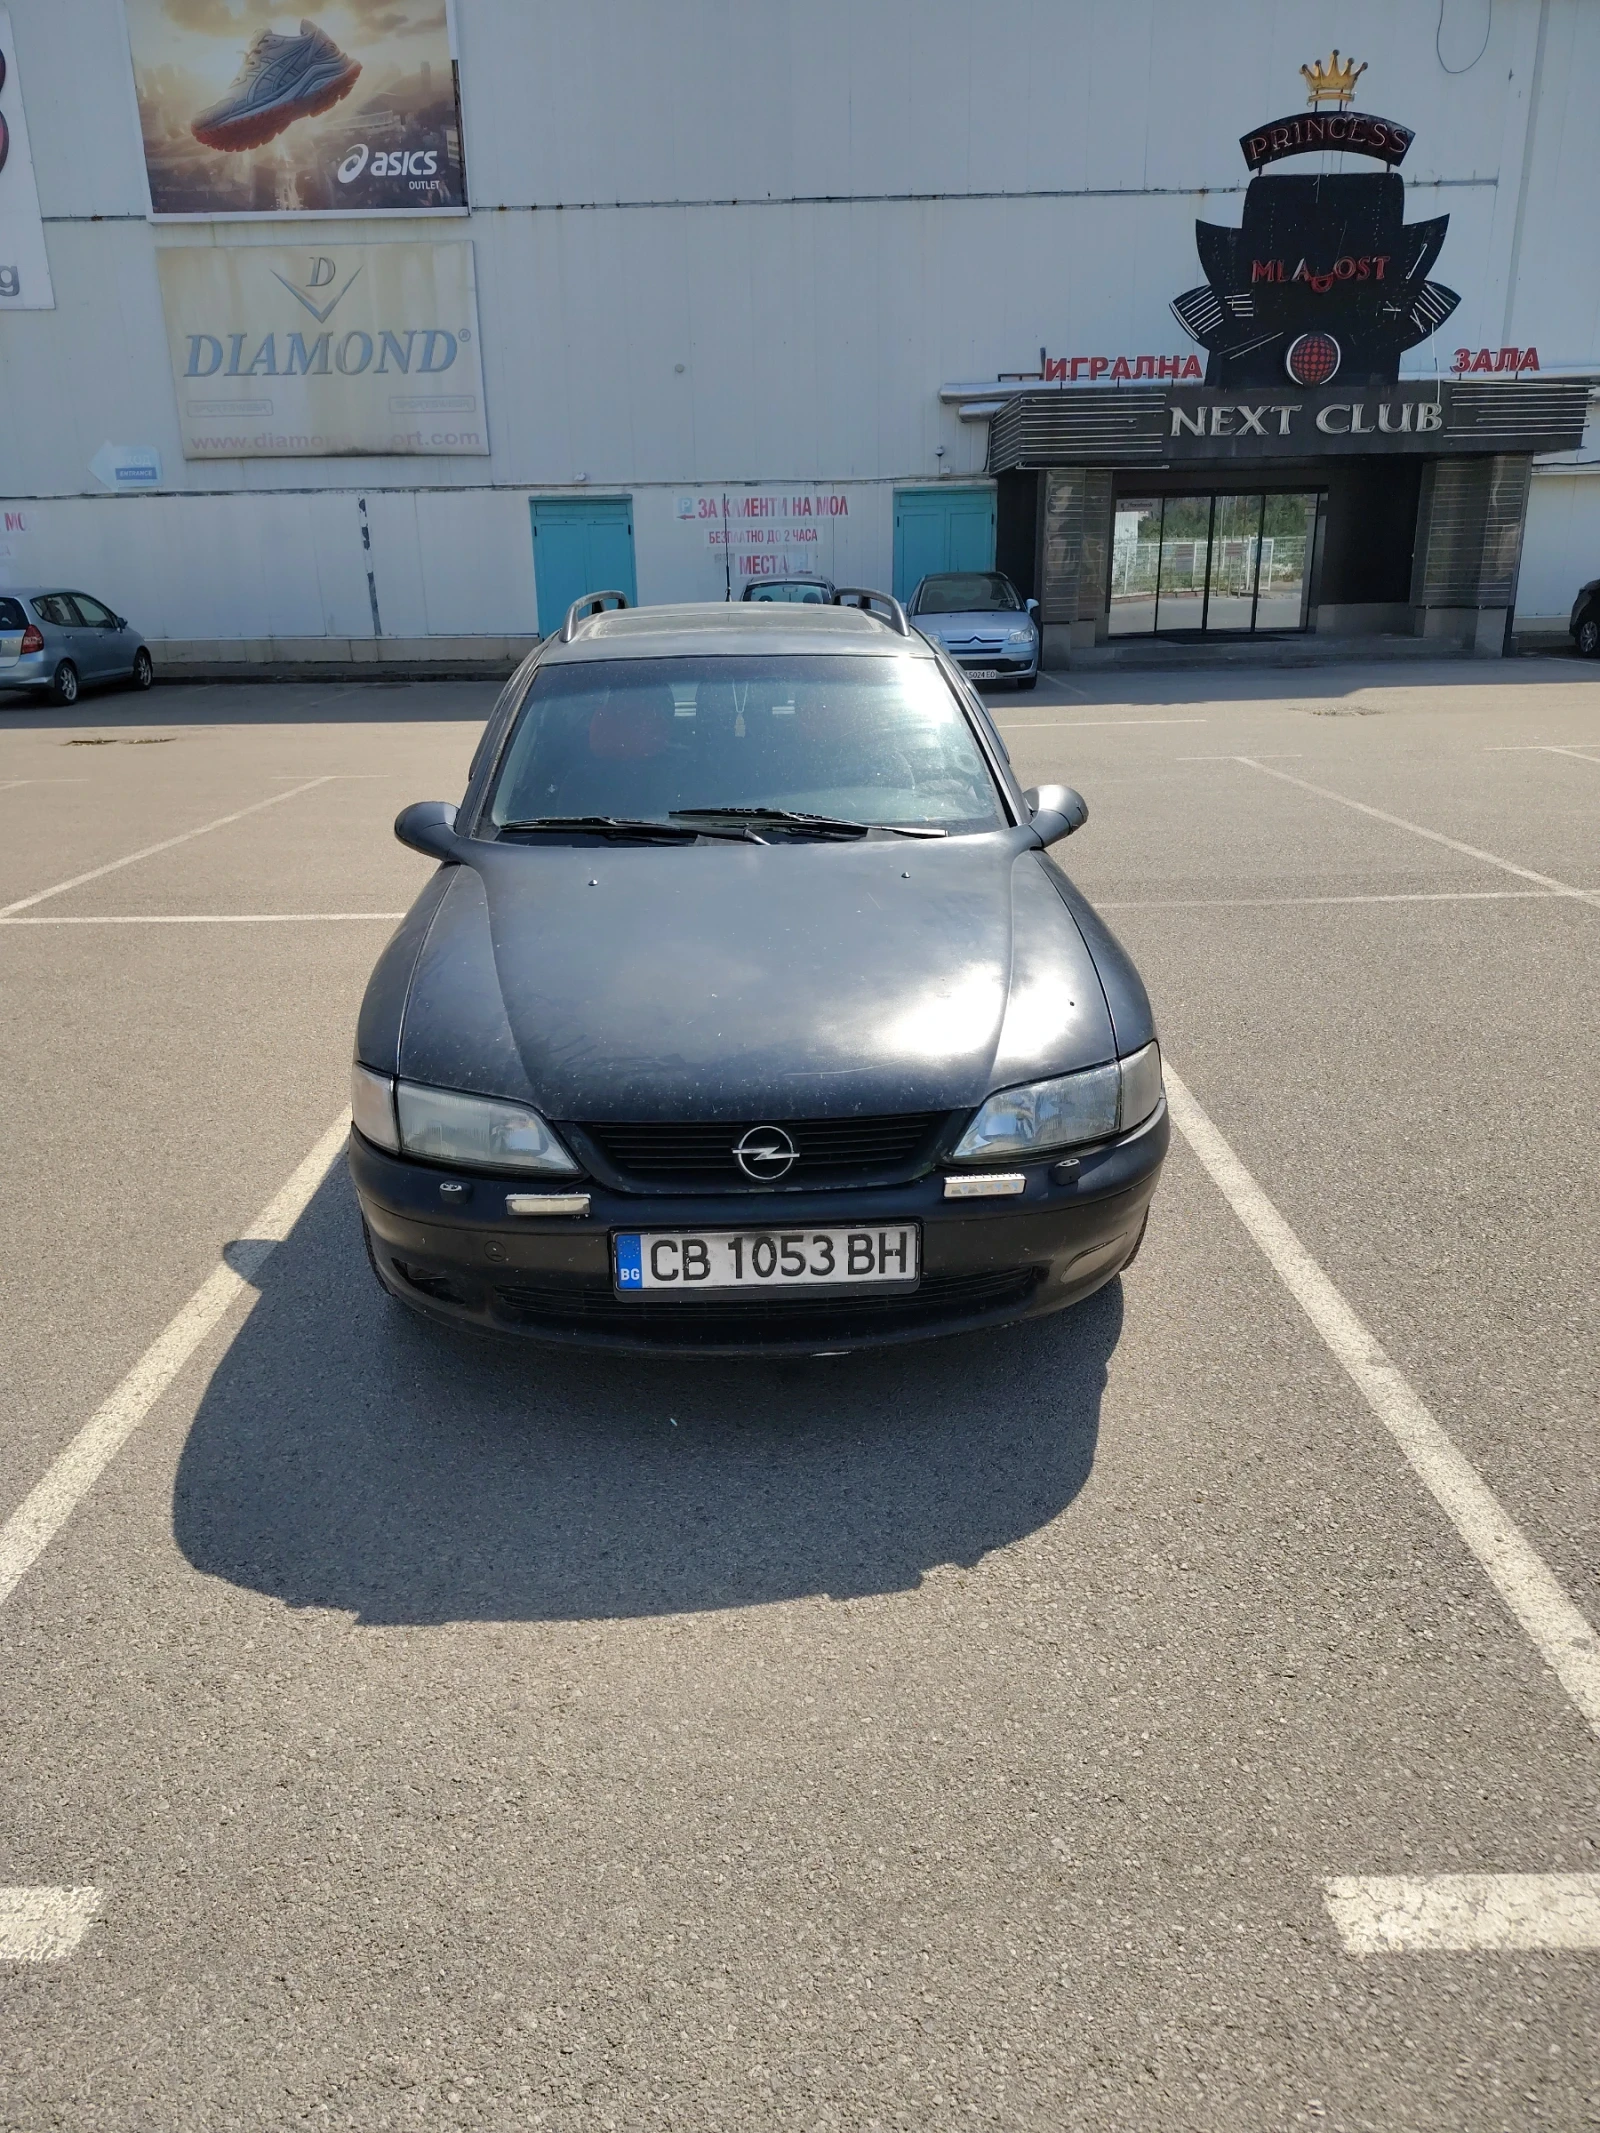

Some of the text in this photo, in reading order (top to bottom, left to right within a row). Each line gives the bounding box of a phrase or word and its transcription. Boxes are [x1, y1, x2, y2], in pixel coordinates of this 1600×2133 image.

[1247, 116, 1407, 161] PRINCESS
[370, 151, 438, 176] asics
[408, 180, 440, 190] OUTLET
[182, 329, 458, 378] DIAMOND
[1044, 347, 1540, 382] ИГРАЛНА ЗАЛА
[1170, 402, 1443, 437] NEXT CLUB
[120, 470, 153, 478] ENTRANCE
[698, 498, 718, 518] ЗА
[792, 496, 812, 517] НА
[817, 495, 849, 516] МОЛ
[767, 530, 781, 544] ДО
[784, 529, 790, 542] 2
[793, 528, 818, 542] ЧАСА
[739, 554, 789, 575] МЕСТА
[728, 1234, 836, 1280] 1053
[620, 1268, 640, 1281] BG
